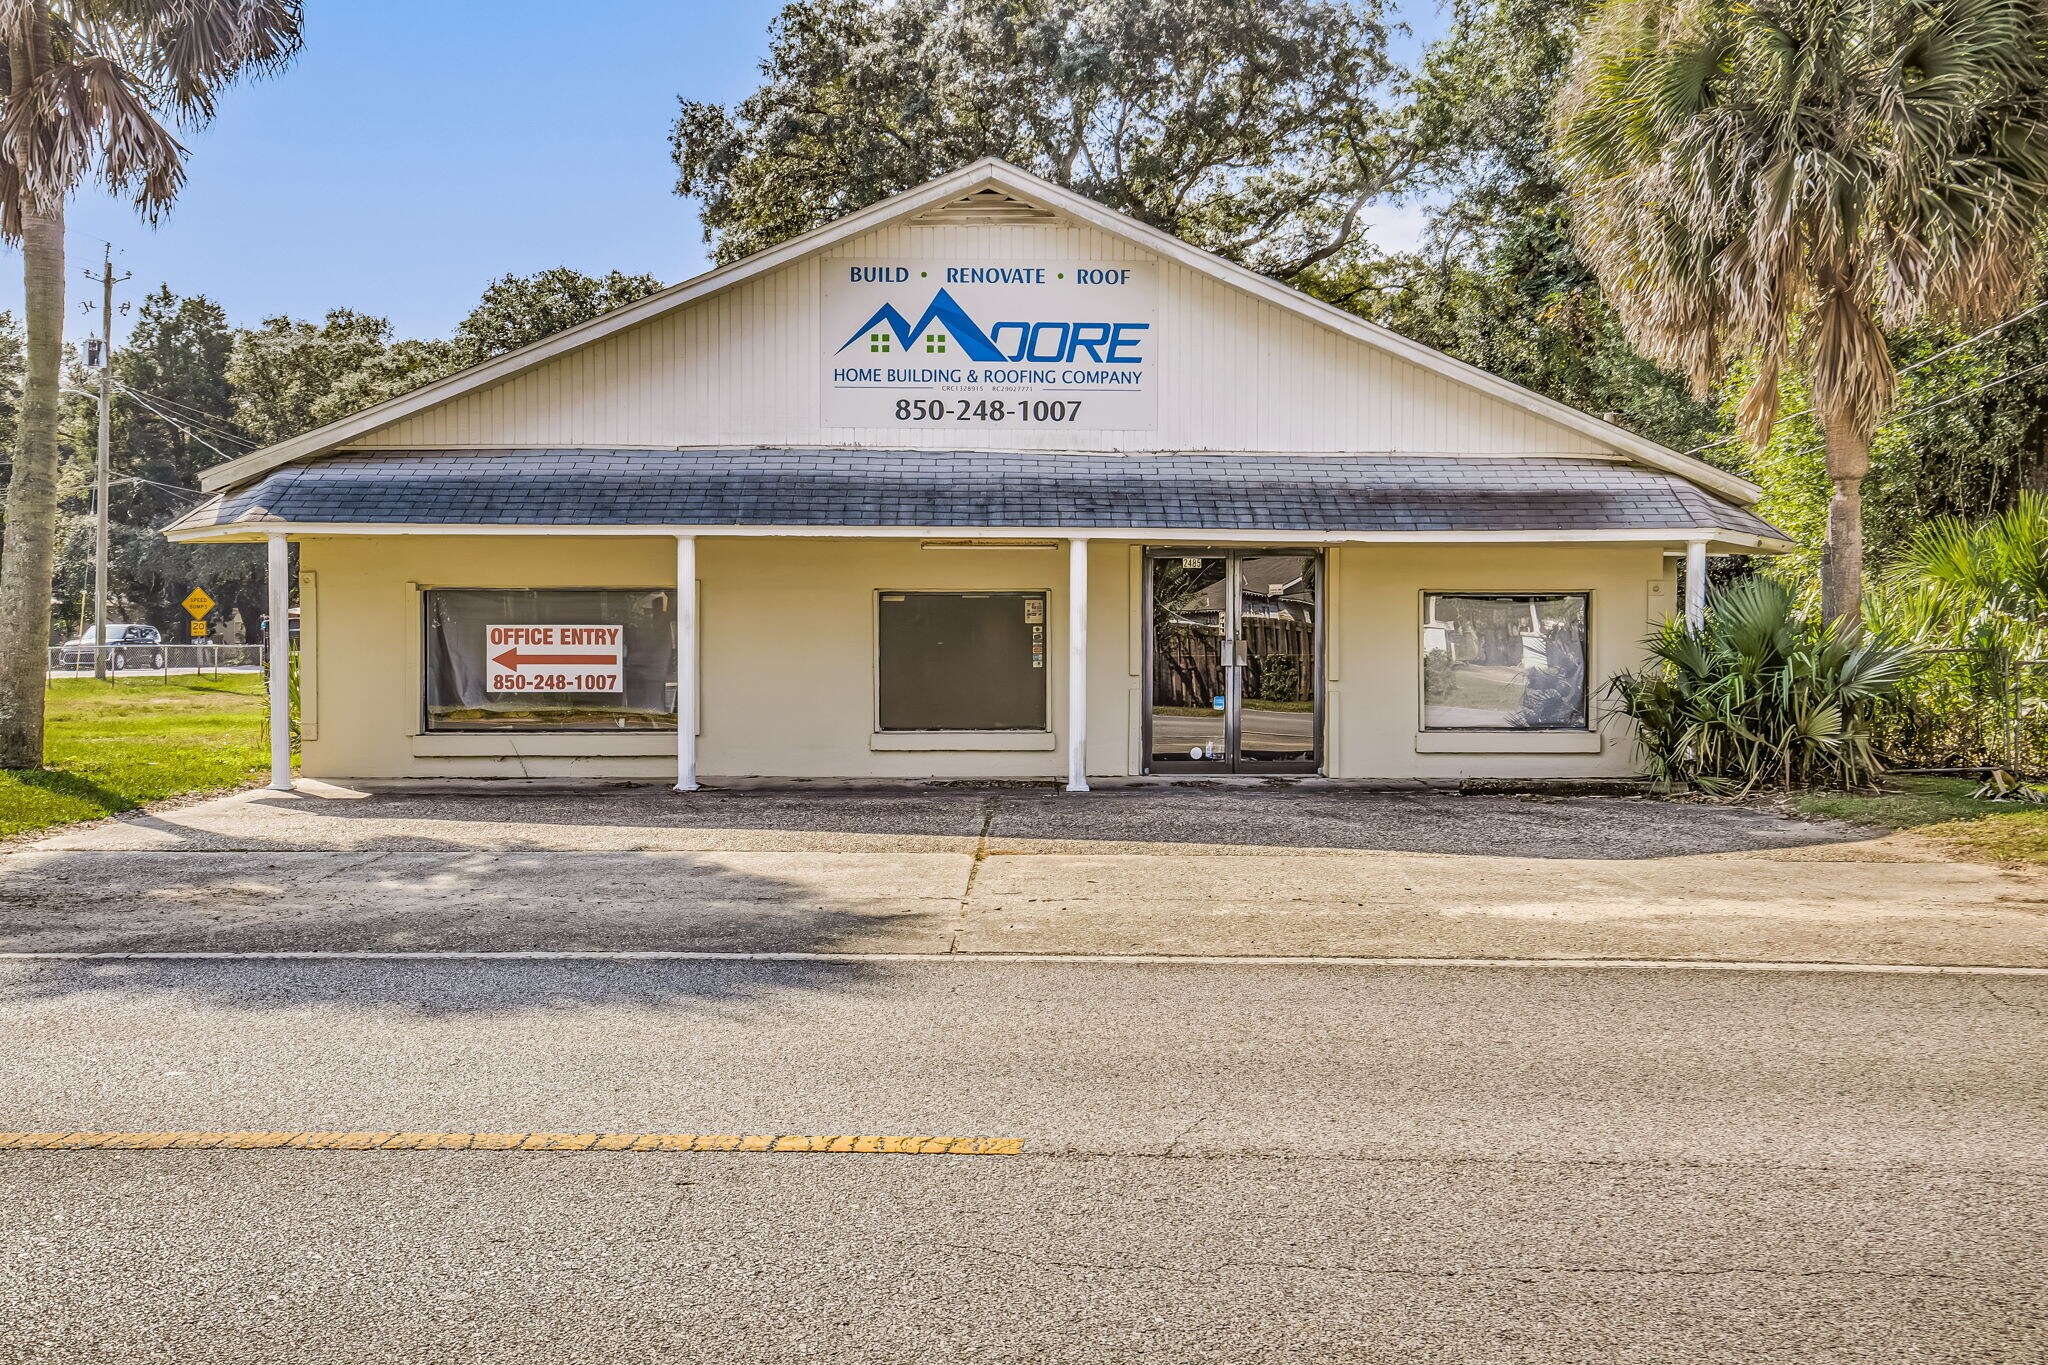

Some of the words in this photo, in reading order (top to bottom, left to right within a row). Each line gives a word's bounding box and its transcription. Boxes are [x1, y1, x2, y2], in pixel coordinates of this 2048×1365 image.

[850, 267, 909, 283] BUILD
[946, 267, 1046, 284] RENOVATE
[1076, 269, 1131, 285] ROOF
[834, 368, 882, 382] HOME
[887, 369, 961, 383] BUILDING
[967, 369, 979, 383] &
[984, 369, 1056, 384] ROOFING
[1062, 370, 1143, 385] COMPANY
[895, 399, 1083, 422] 850-248-1007
[1183, 558, 1201, 568] 2485
[490, 627, 554, 645] OFFICE
[560, 627, 619, 645] ENTRY
[493, 674, 617, 690] 850-248-1007
